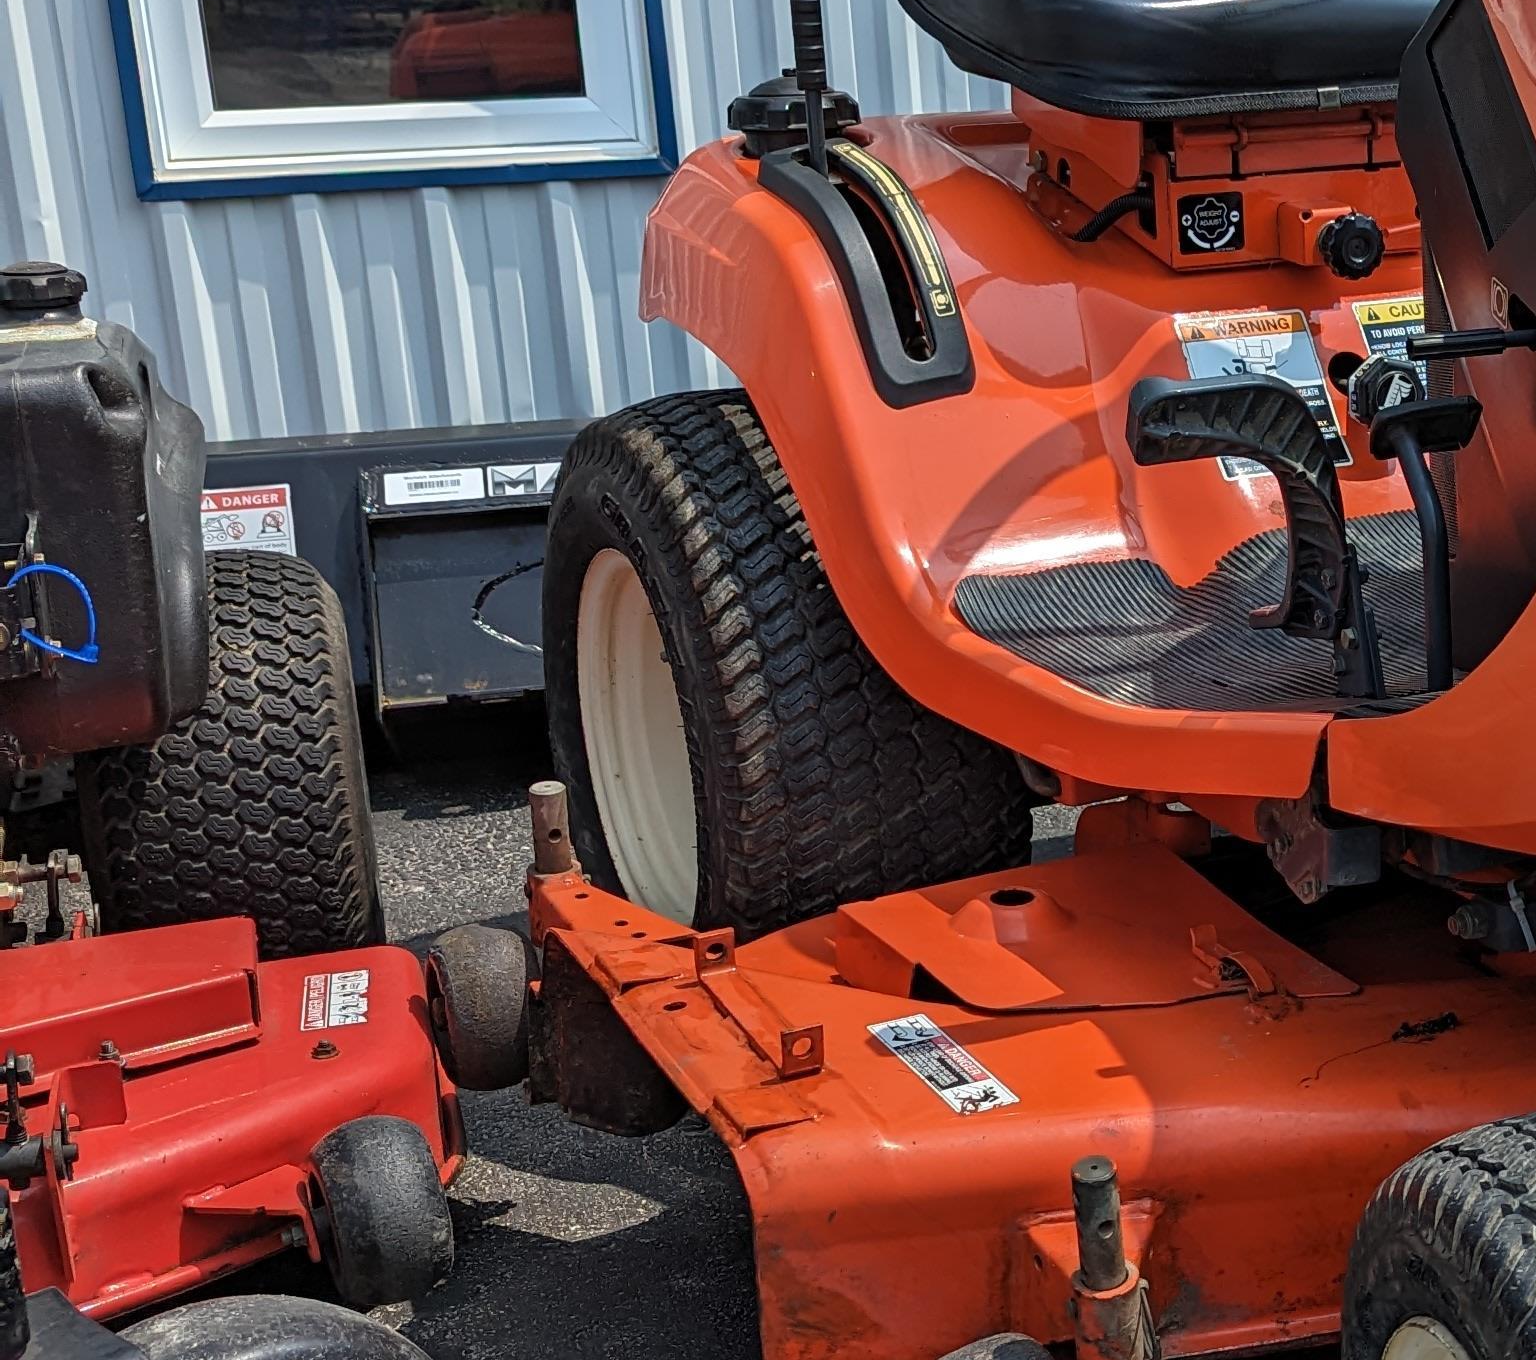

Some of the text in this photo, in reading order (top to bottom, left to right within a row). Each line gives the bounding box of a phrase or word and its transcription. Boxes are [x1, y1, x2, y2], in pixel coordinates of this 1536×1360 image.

[1214, 317, 1290, 337] WARNING
[1371, 330, 1382, 339] TO
[1383, 326, 1406, 338] AVOID
[221, 493, 279, 508] DANGER
[945, 1046, 982, 1077] DANGER
